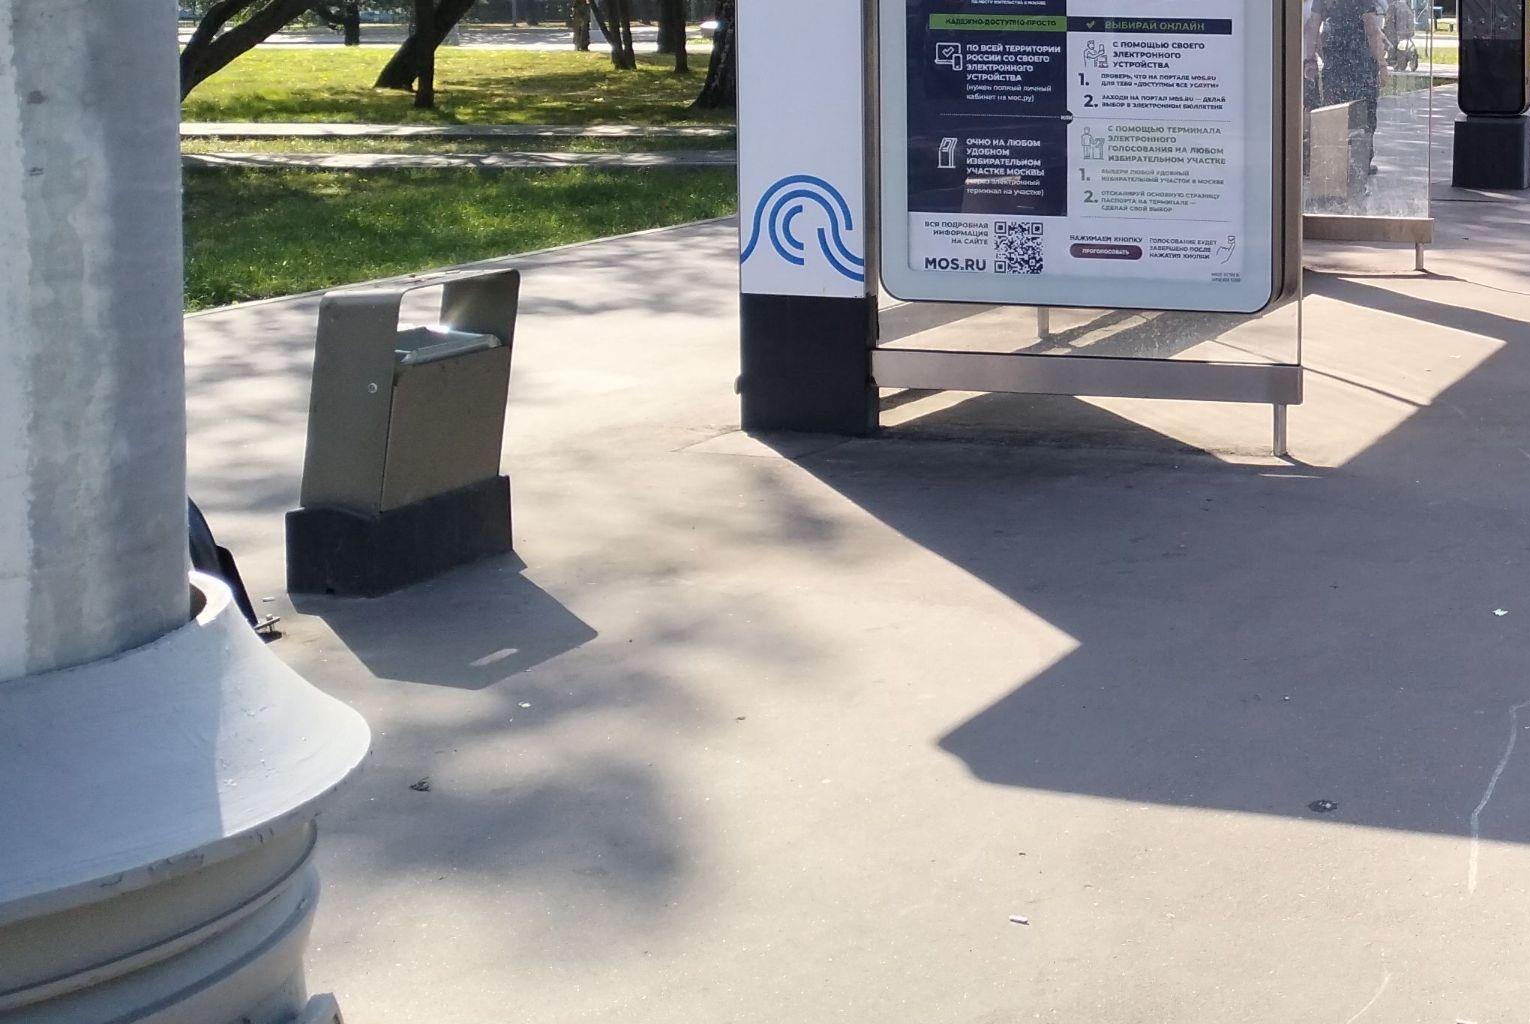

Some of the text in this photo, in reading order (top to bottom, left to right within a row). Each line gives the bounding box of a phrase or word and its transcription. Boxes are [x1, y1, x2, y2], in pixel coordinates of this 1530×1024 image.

[1078, 73, 1090, 86] 1.
[1084, 94, 1098, 108] 2.
[1079, 168, 1091, 181] 1.
[1084, 190, 1098, 204] 2.
[925, 257, 986, 271] MOS.RU
